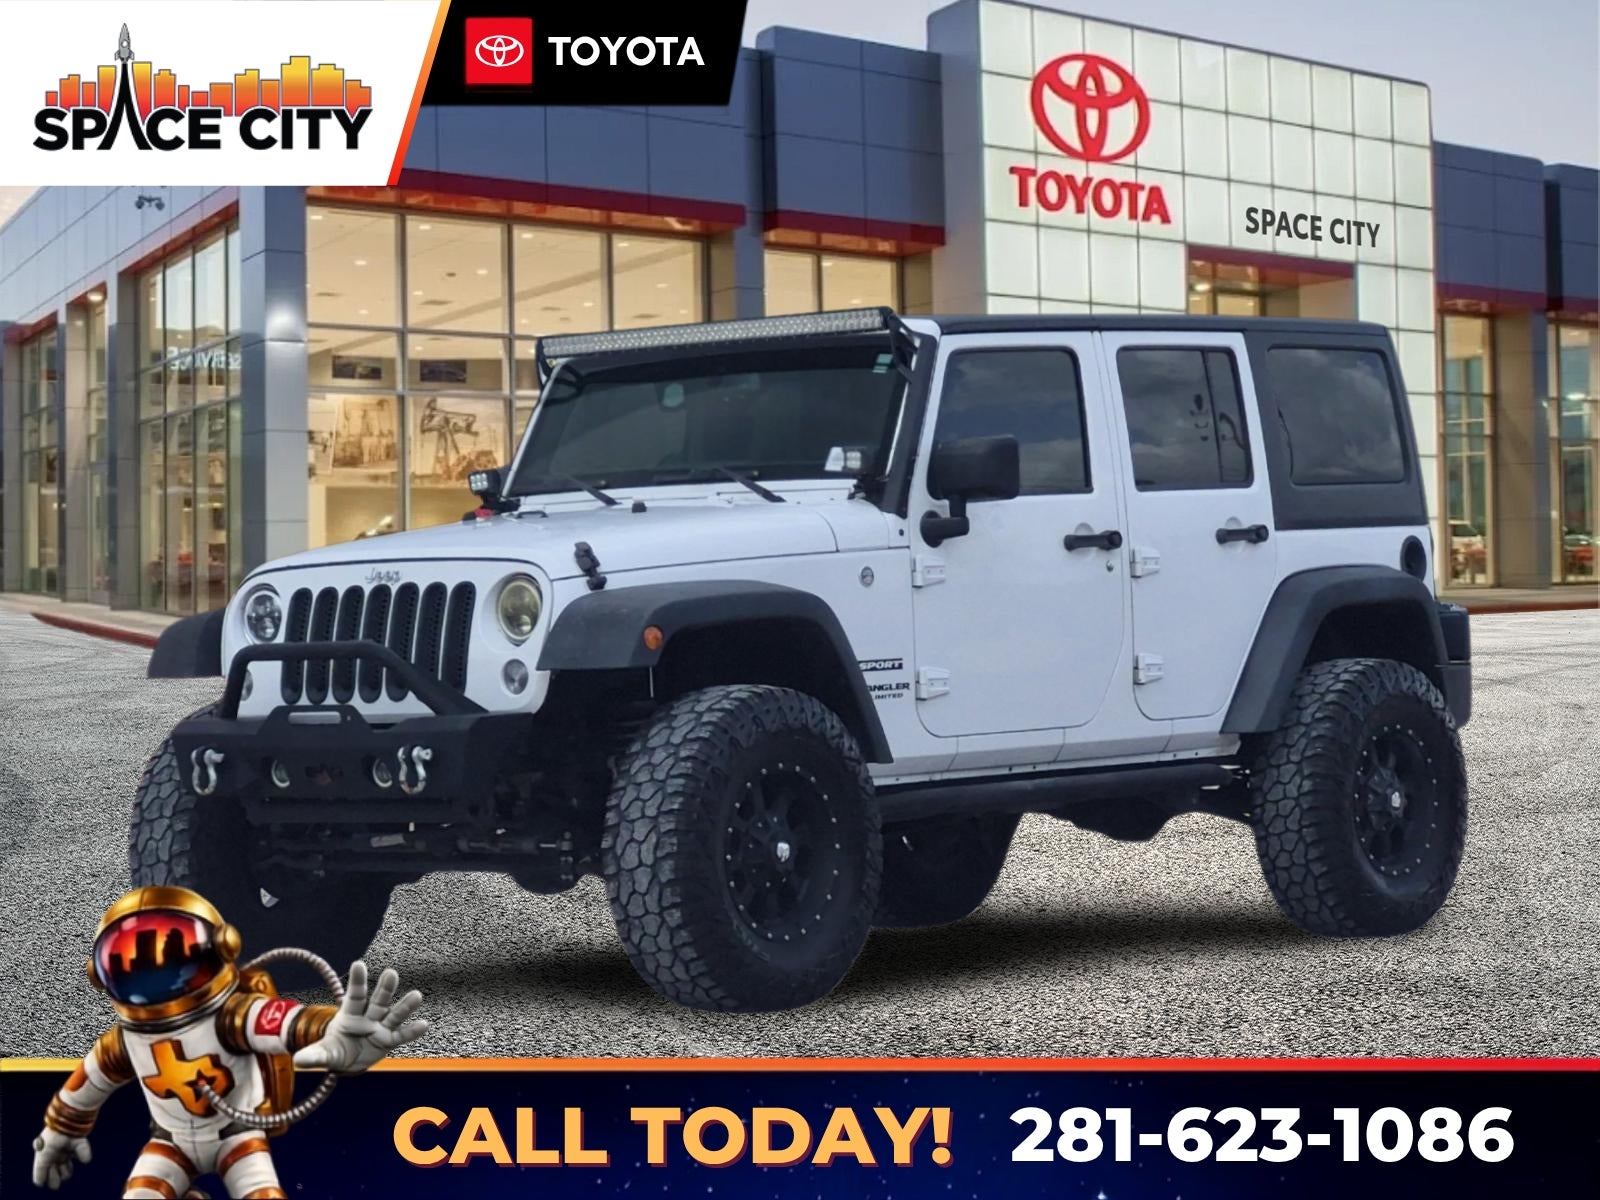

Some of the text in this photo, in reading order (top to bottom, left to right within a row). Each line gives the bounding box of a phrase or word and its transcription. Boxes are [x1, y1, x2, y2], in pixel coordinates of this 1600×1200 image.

[1008, 166, 1171, 224] TOYOTA
[1245, 206, 1381, 248] SPACE CITY
[859, 661, 901, 671] SPORT
[867, 683, 910, 691] ANGLER
